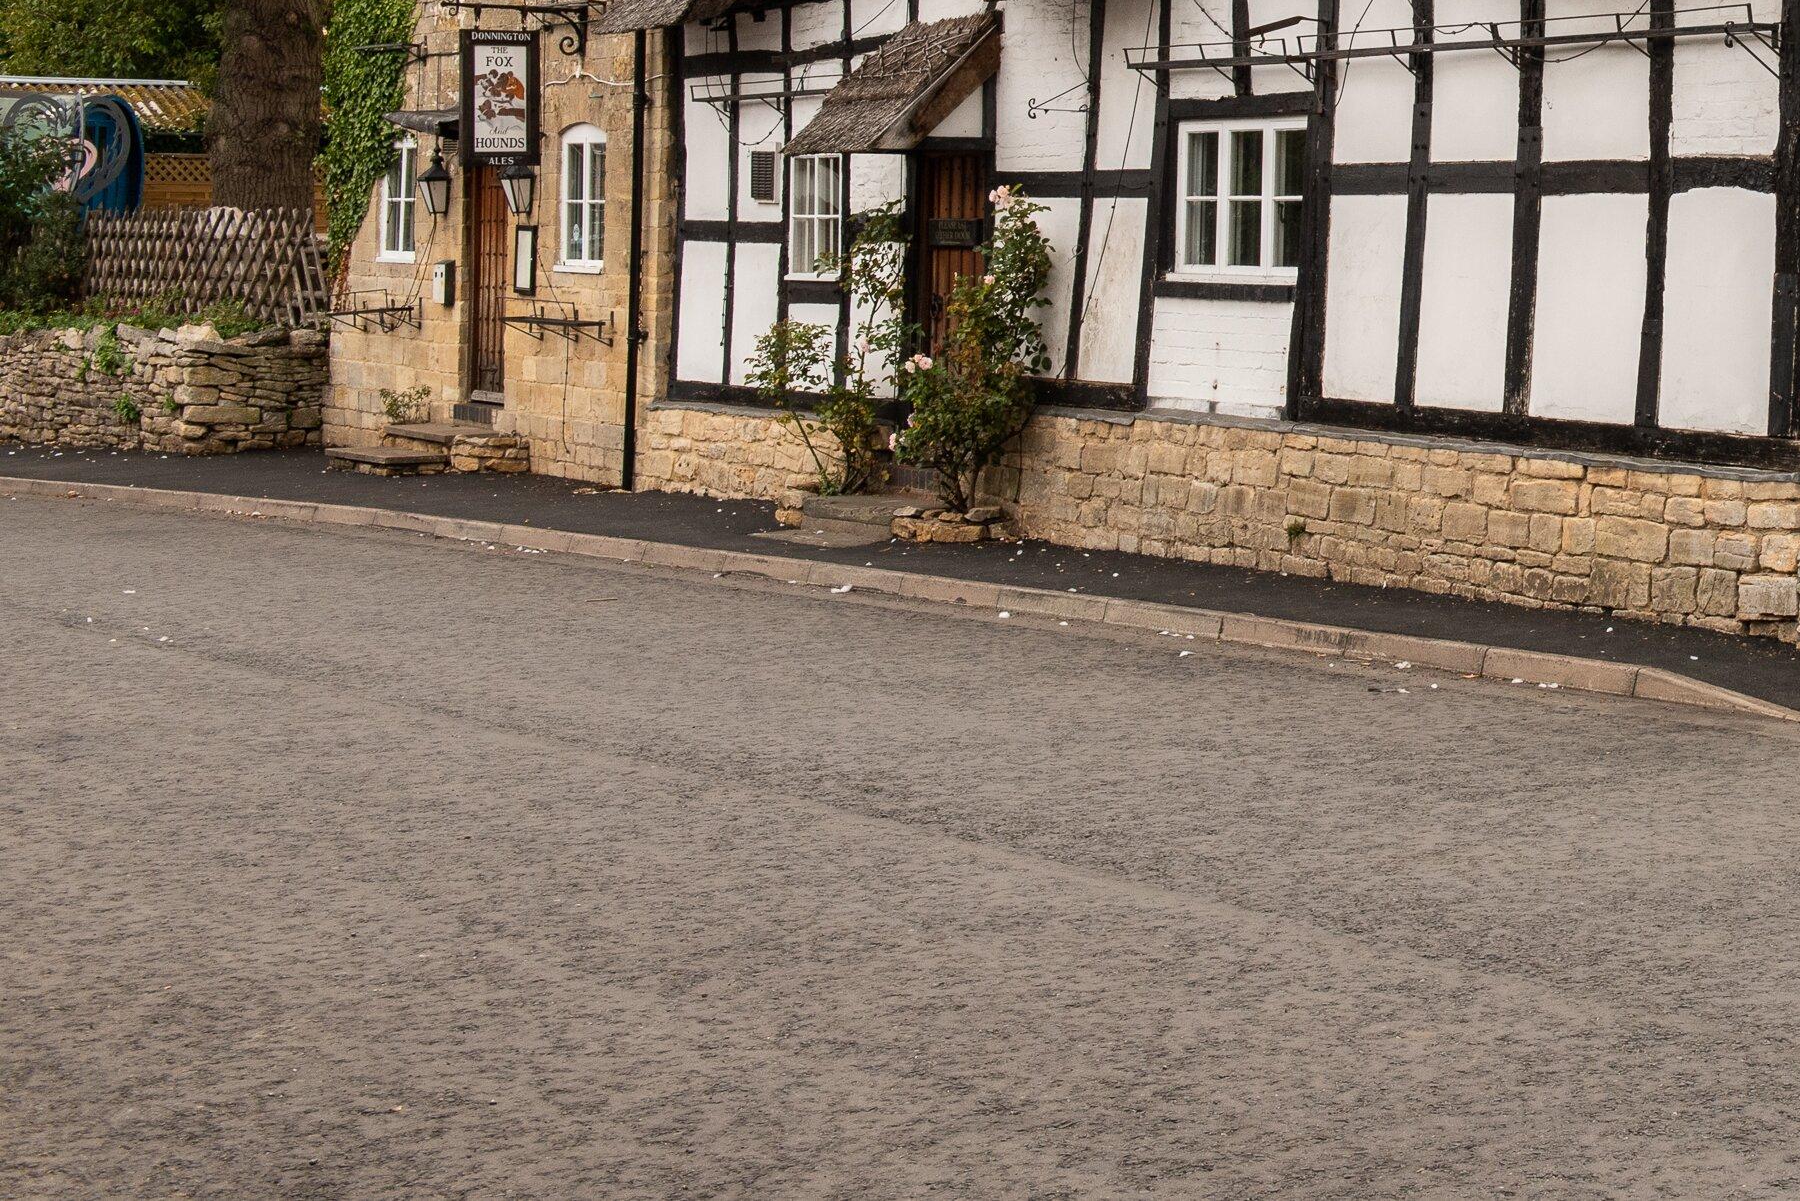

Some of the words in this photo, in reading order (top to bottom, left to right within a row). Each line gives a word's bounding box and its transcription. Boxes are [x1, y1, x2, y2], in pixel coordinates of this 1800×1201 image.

[471, 31, 531, 41] DONNINGTON
[490, 46, 508, 54] THE
[486, 57, 513, 67] FOX
[475, 137, 525, 149] HOUNDS
[488, 157, 514, 165] ALES
